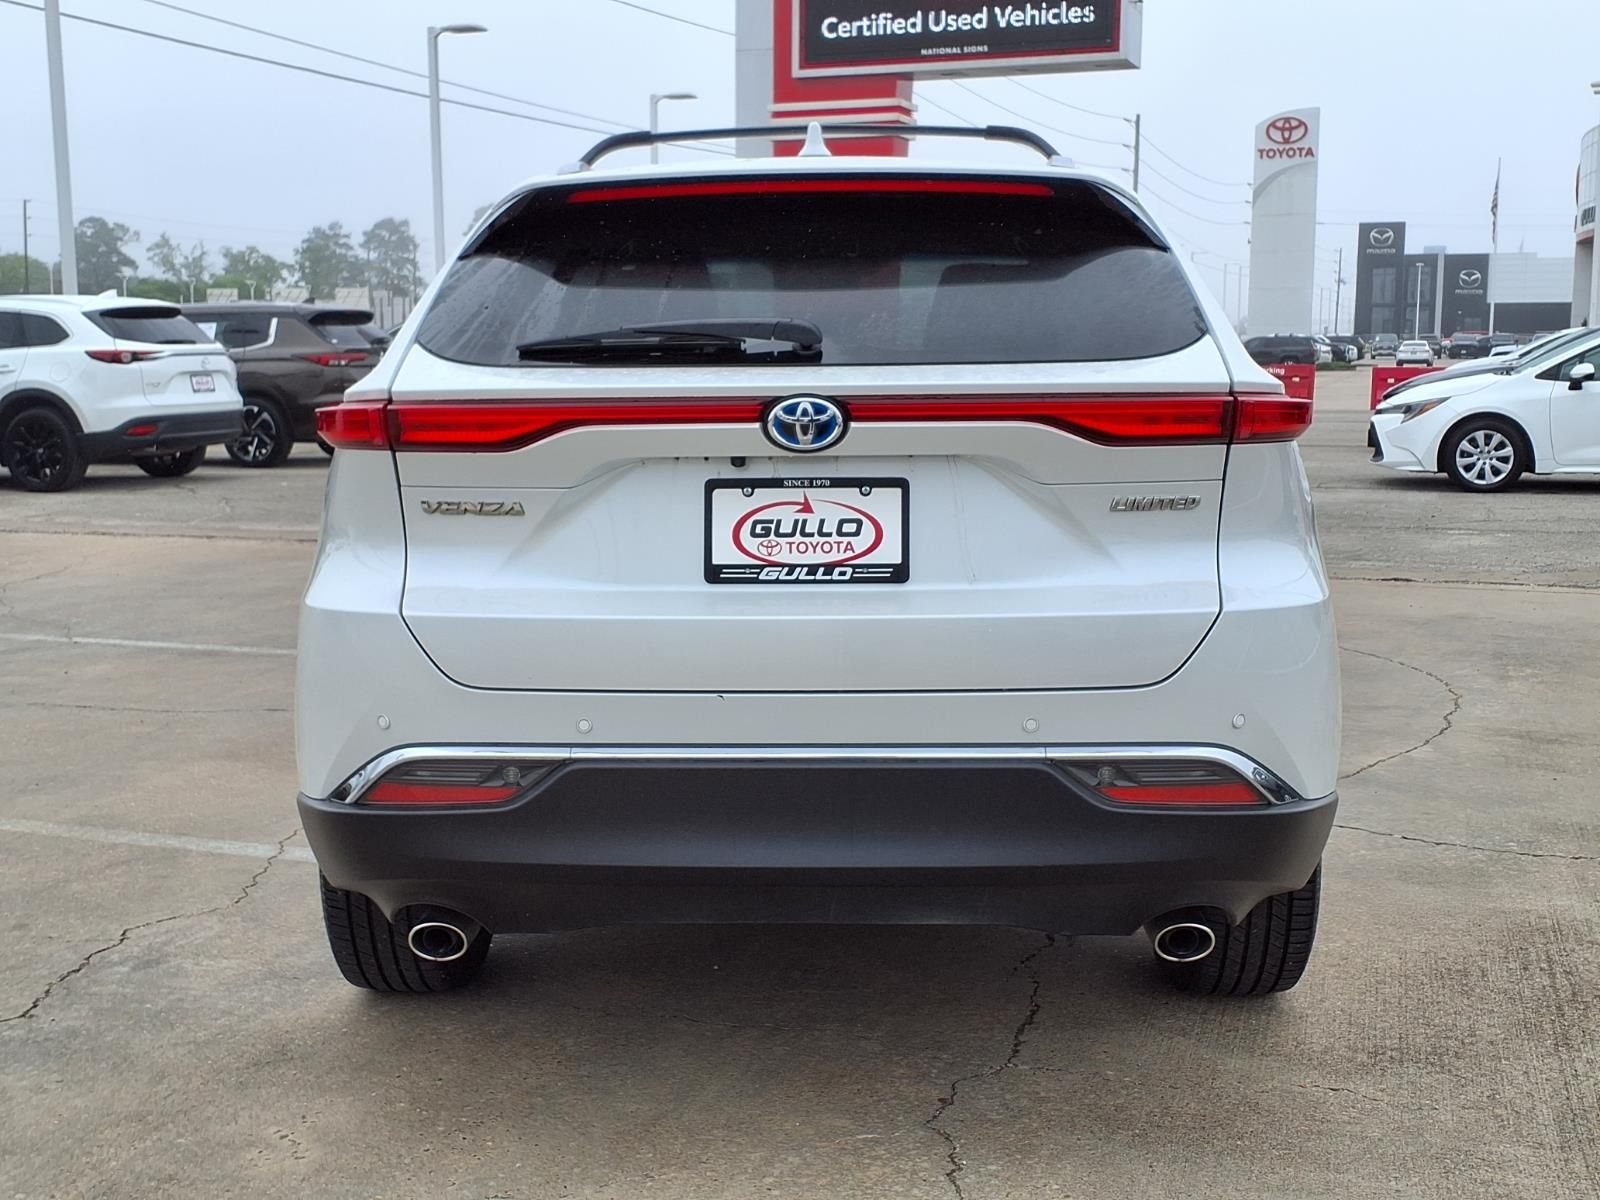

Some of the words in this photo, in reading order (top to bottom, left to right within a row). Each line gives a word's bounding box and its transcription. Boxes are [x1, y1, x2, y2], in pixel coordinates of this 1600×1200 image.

[821, 10, 923, 39] Certified
[928, 6, 988, 33] Used
[994, 1, 1096, 29] Vehicles
[920, 46, 962, 56] NATIONAL
[963, 44, 989, 54] SIGNS
[1257, 146, 1315, 159] TOYOTA
[783, 479, 810, 487] SINCE
[812, 479, 830, 487] 1970
[420, 500, 526, 516] VENZA
[1110, 496, 1201, 512] LIMITED
[750, 517, 863, 538] GULLO
[786, 541, 856, 554] TOYOTA
[758, 566, 853, 580] GULLO
